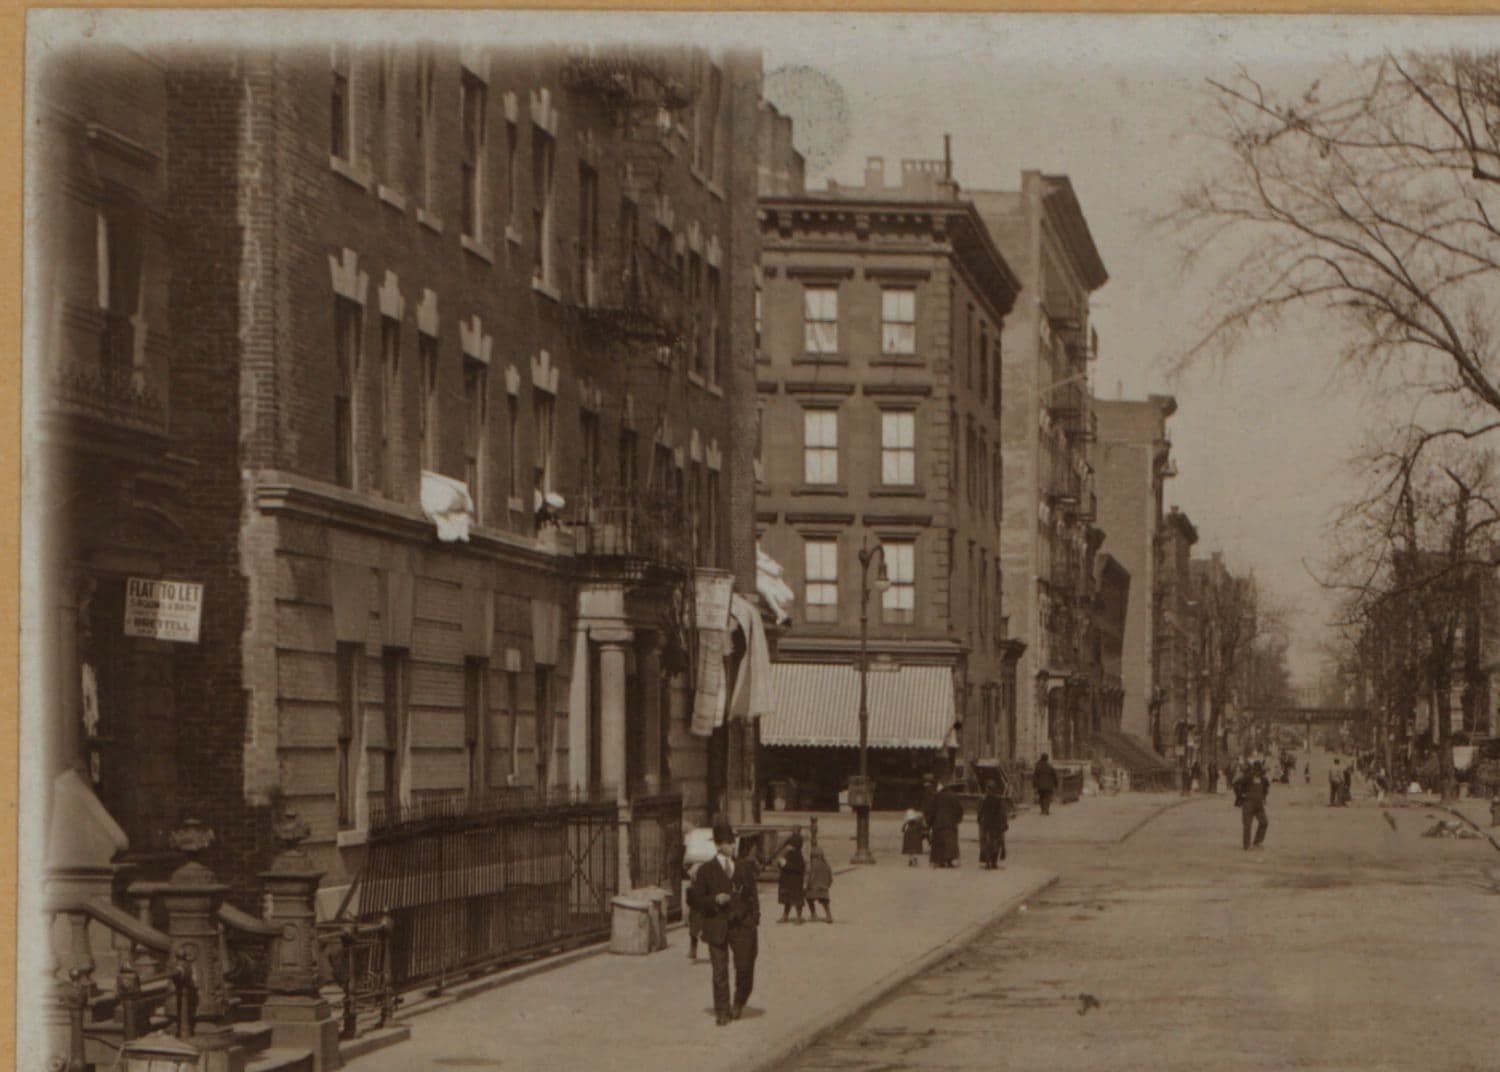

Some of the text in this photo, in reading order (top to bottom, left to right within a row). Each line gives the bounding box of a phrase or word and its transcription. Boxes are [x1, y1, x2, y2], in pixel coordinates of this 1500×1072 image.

[129, 579, 199, 602] FLAT TO LET
